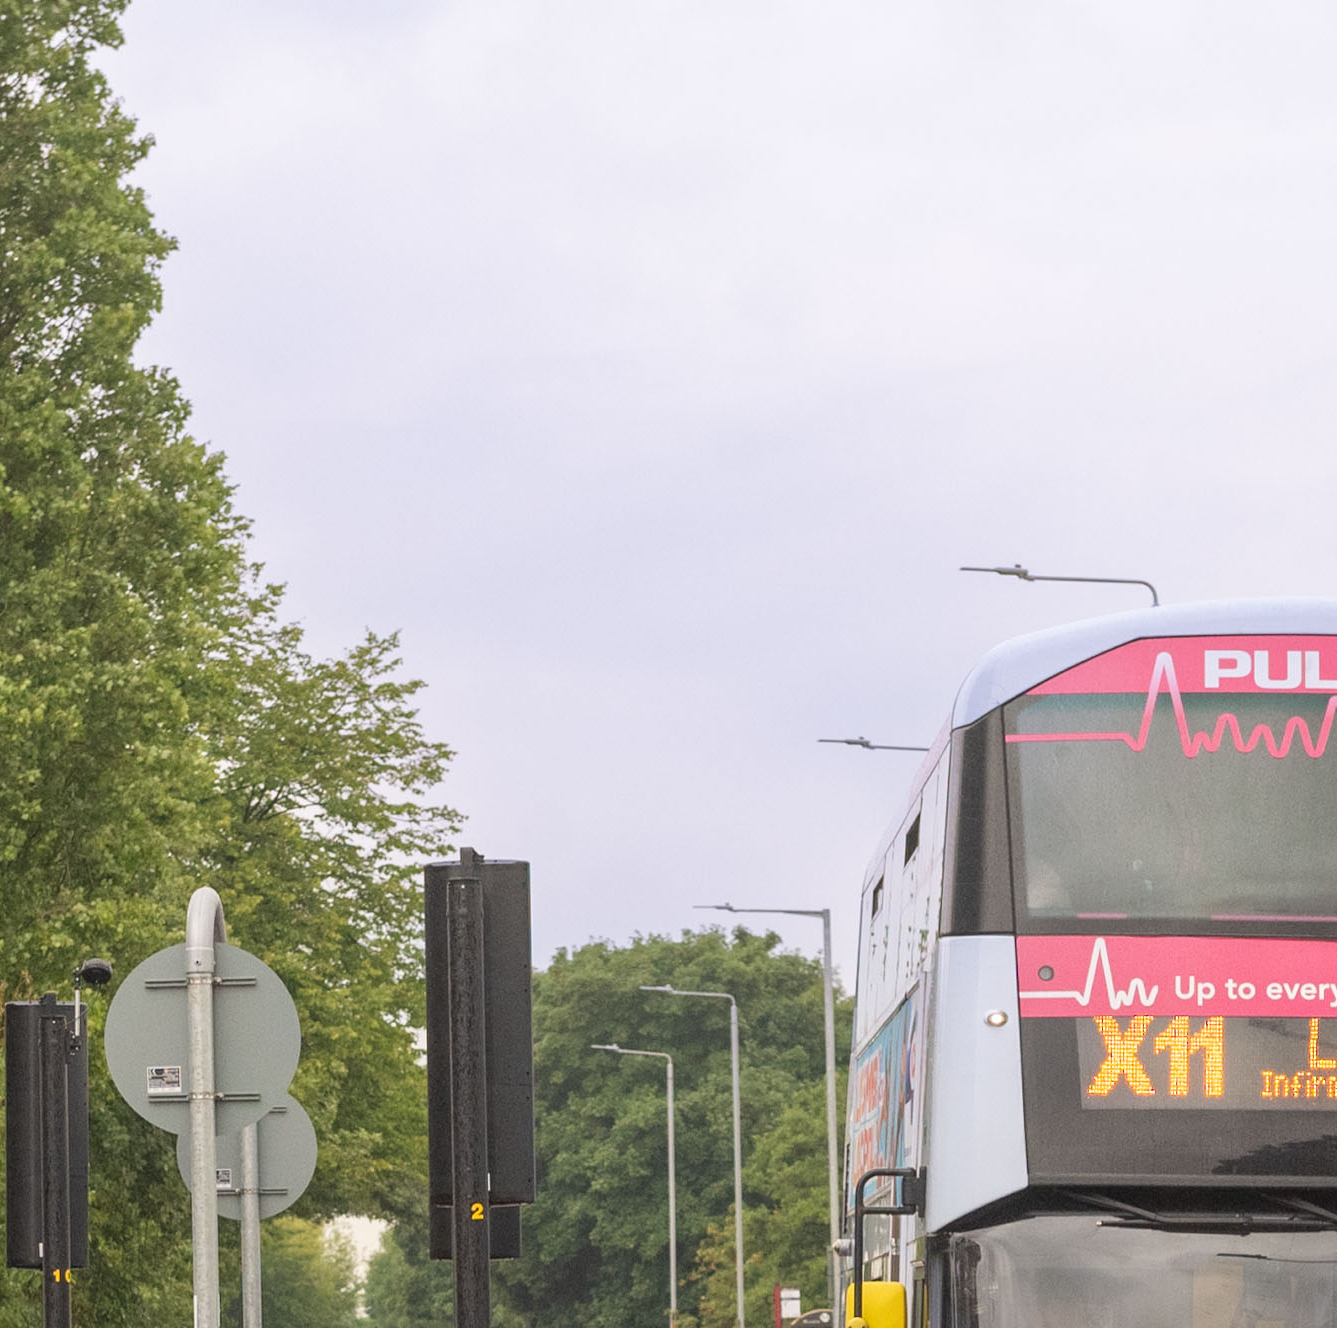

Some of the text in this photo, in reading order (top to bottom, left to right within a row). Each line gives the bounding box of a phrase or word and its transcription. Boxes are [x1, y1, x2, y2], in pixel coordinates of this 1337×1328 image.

[1174, 975, 1216, 1006] Up
[1224, 977, 1256, 1001] to
[1087, 1015, 1226, 1098] X11
[471, 1202, 484, 1220] 2
